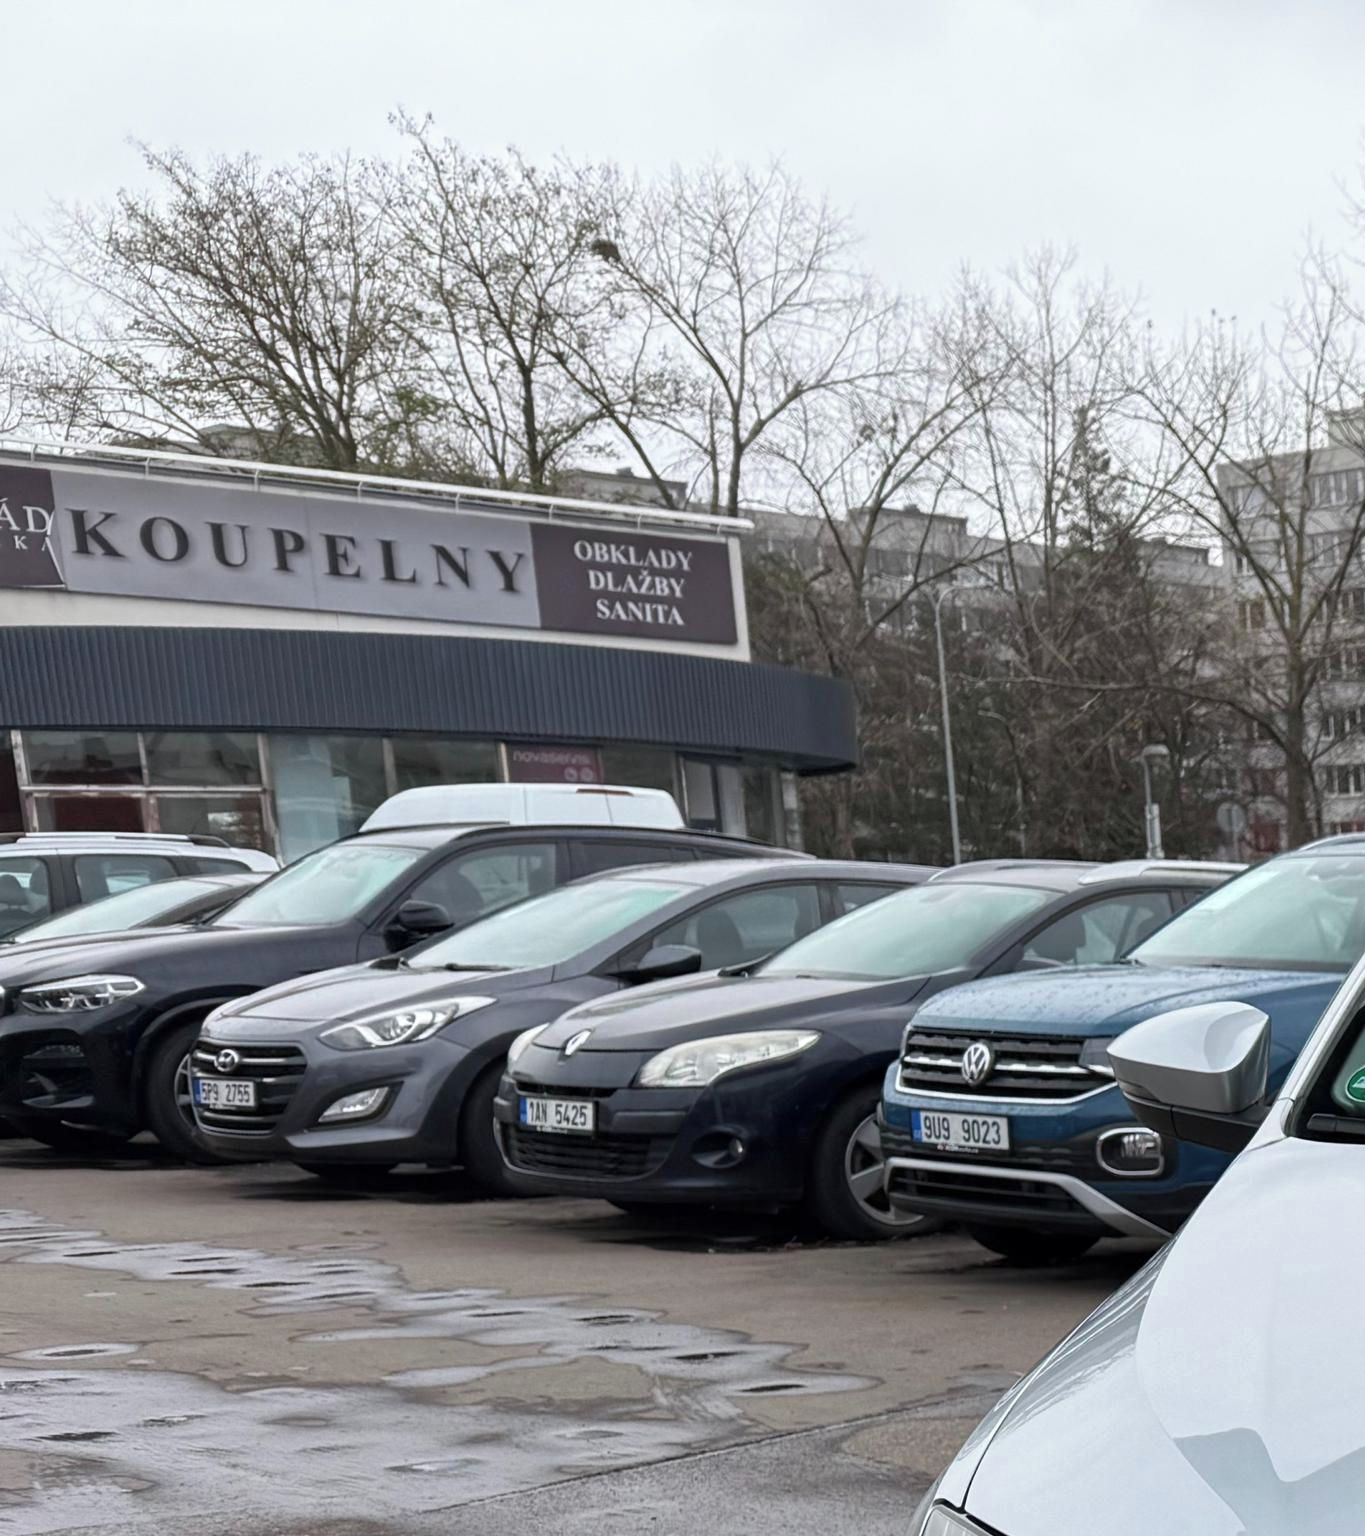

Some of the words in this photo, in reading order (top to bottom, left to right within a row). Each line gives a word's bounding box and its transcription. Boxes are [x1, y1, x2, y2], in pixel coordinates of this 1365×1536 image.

[64, 508, 525, 593] KOUPELNY
[574, 540, 692, 571] OBKLADY
[588, 569, 685, 598] DLAŽBY
[596, 599, 685, 626] SANITA
[225, 1083, 250, 1103] 2755
[555, 1103, 588, 1126] 5425
[924, 1115, 951, 1140] 9U9
[961, 1118, 1001, 1145] 9023
